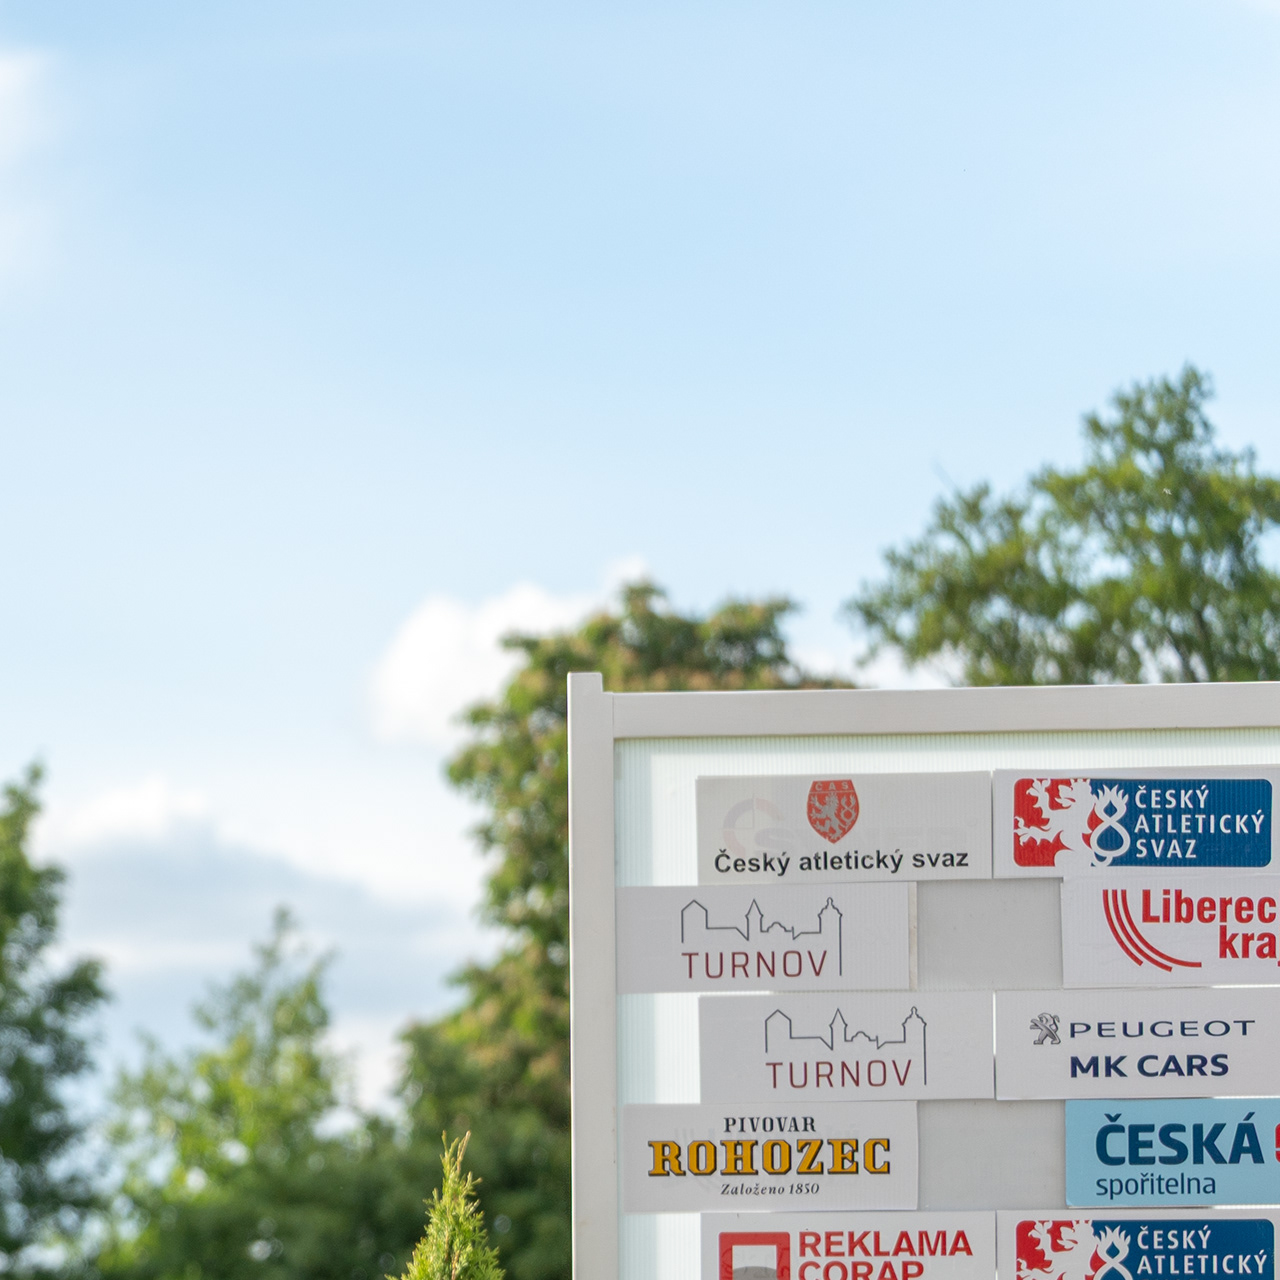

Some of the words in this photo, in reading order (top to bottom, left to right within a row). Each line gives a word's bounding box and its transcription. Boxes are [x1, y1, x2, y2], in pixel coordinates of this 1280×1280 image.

[1135, 783, 1209, 809] ČESKÝ
[1135, 808, 1265, 836] ATLETICKÝ
[714, 850, 791, 876] Český
[798, 848, 903, 874] atletický
[912, 850, 969, 868] svaz
[1135, 838, 1197, 859] SVAZ
[1142, 889, 1280, 923] Liberec
[1218, 920, 1280, 967] kra
[682, 951, 827, 979] TURNOV
[1070, 1019, 1255, 1039] PEUGEOT
[766, 1059, 912, 1088] TURNOV
[1070, 1055, 1128, 1078] MK
[1137, 1054, 1229, 1078] CARS
[723, 1116, 816, 1133] PIVOVAR
[1096, 1112, 1264, 1166] ČESKÁ
[648, 1137, 890, 1177] ROHOZEC
[720, 1182, 786, 1197] Založeno
[788, 1183, 819, 1196] 1850
[1096, 1172, 1216, 1199] spořitelna
[800, 1230, 973, 1257] REKLAMA
[1137, 1224, 1211, 1250] ČESKÝ
[1137, 1249, 1267, 1275] ATLETICKÝ
